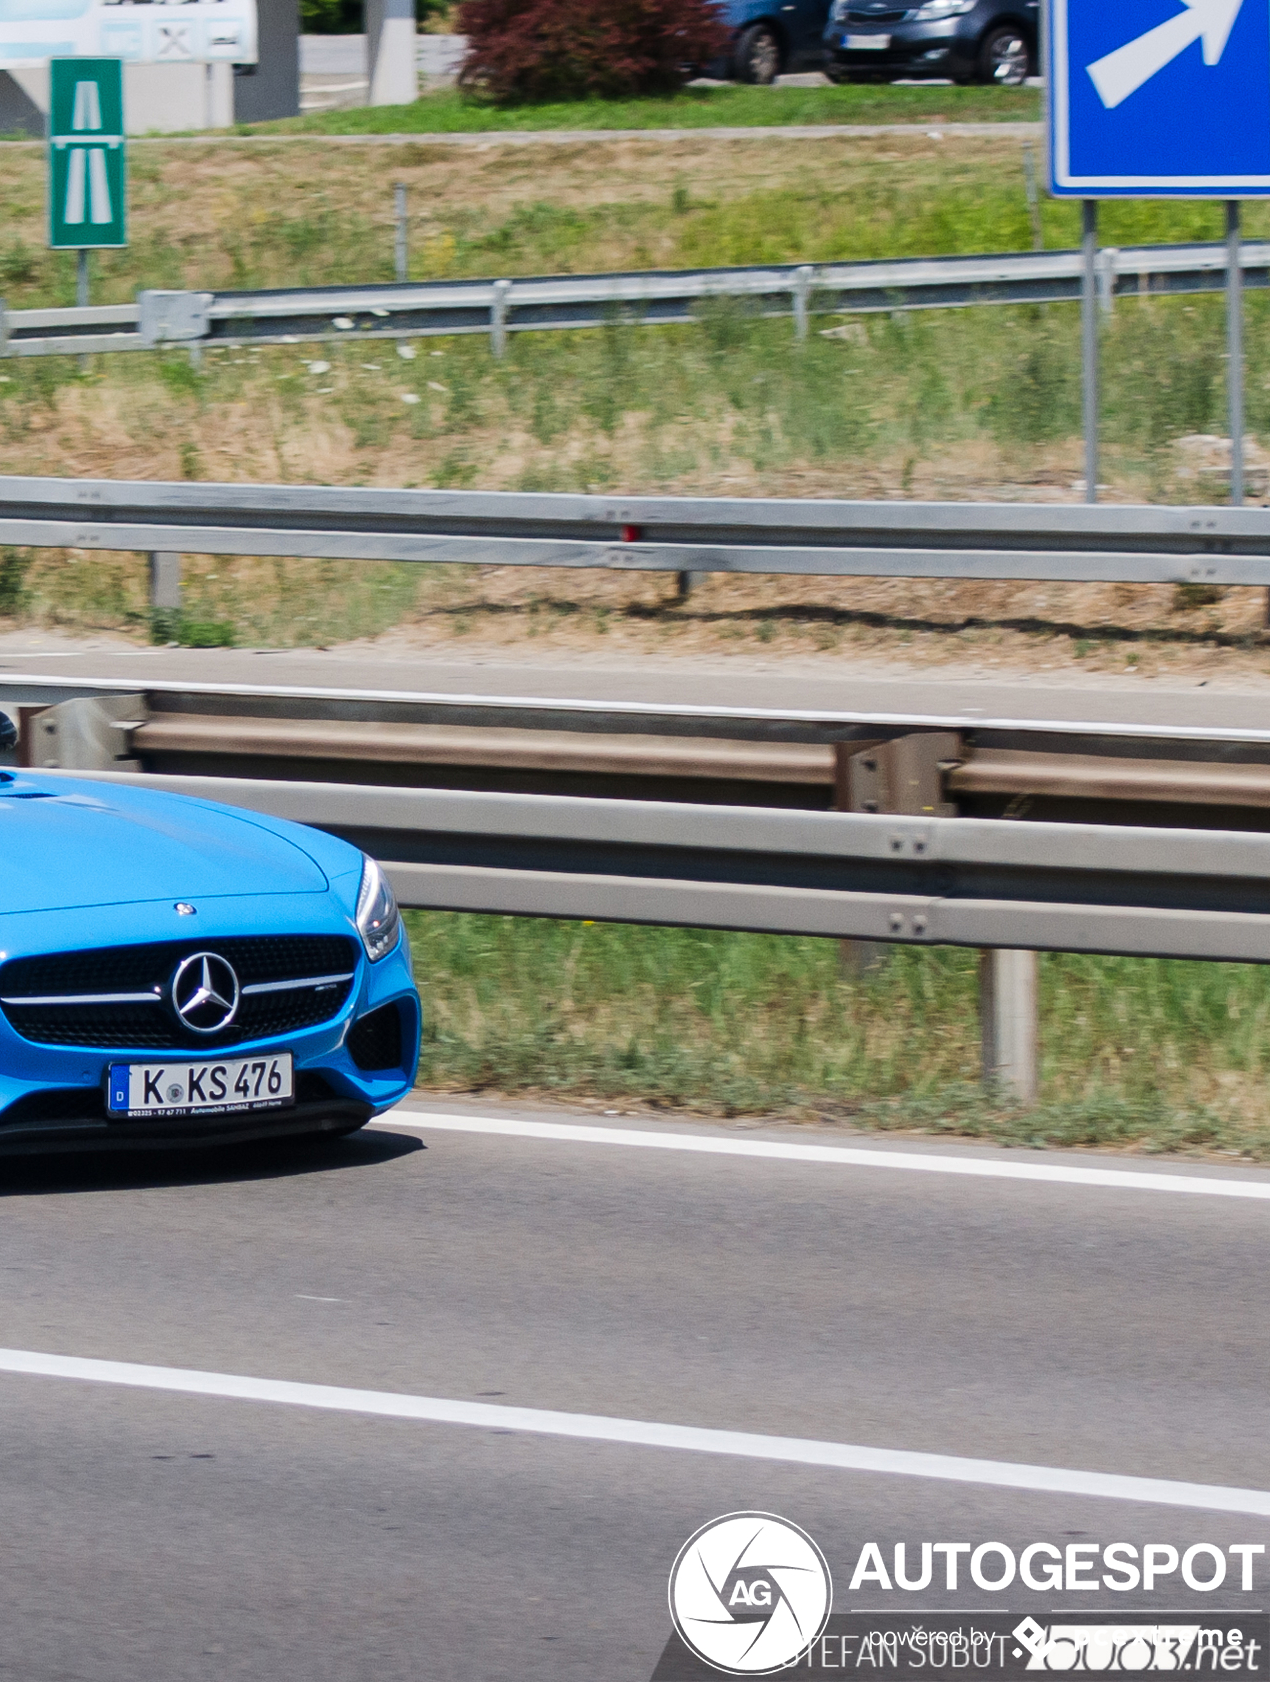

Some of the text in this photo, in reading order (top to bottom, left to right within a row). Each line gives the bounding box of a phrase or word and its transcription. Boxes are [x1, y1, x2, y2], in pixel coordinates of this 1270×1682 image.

[144, 1060, 282, 1104] K KS 476
[116, 1091, 124, 1102] D
